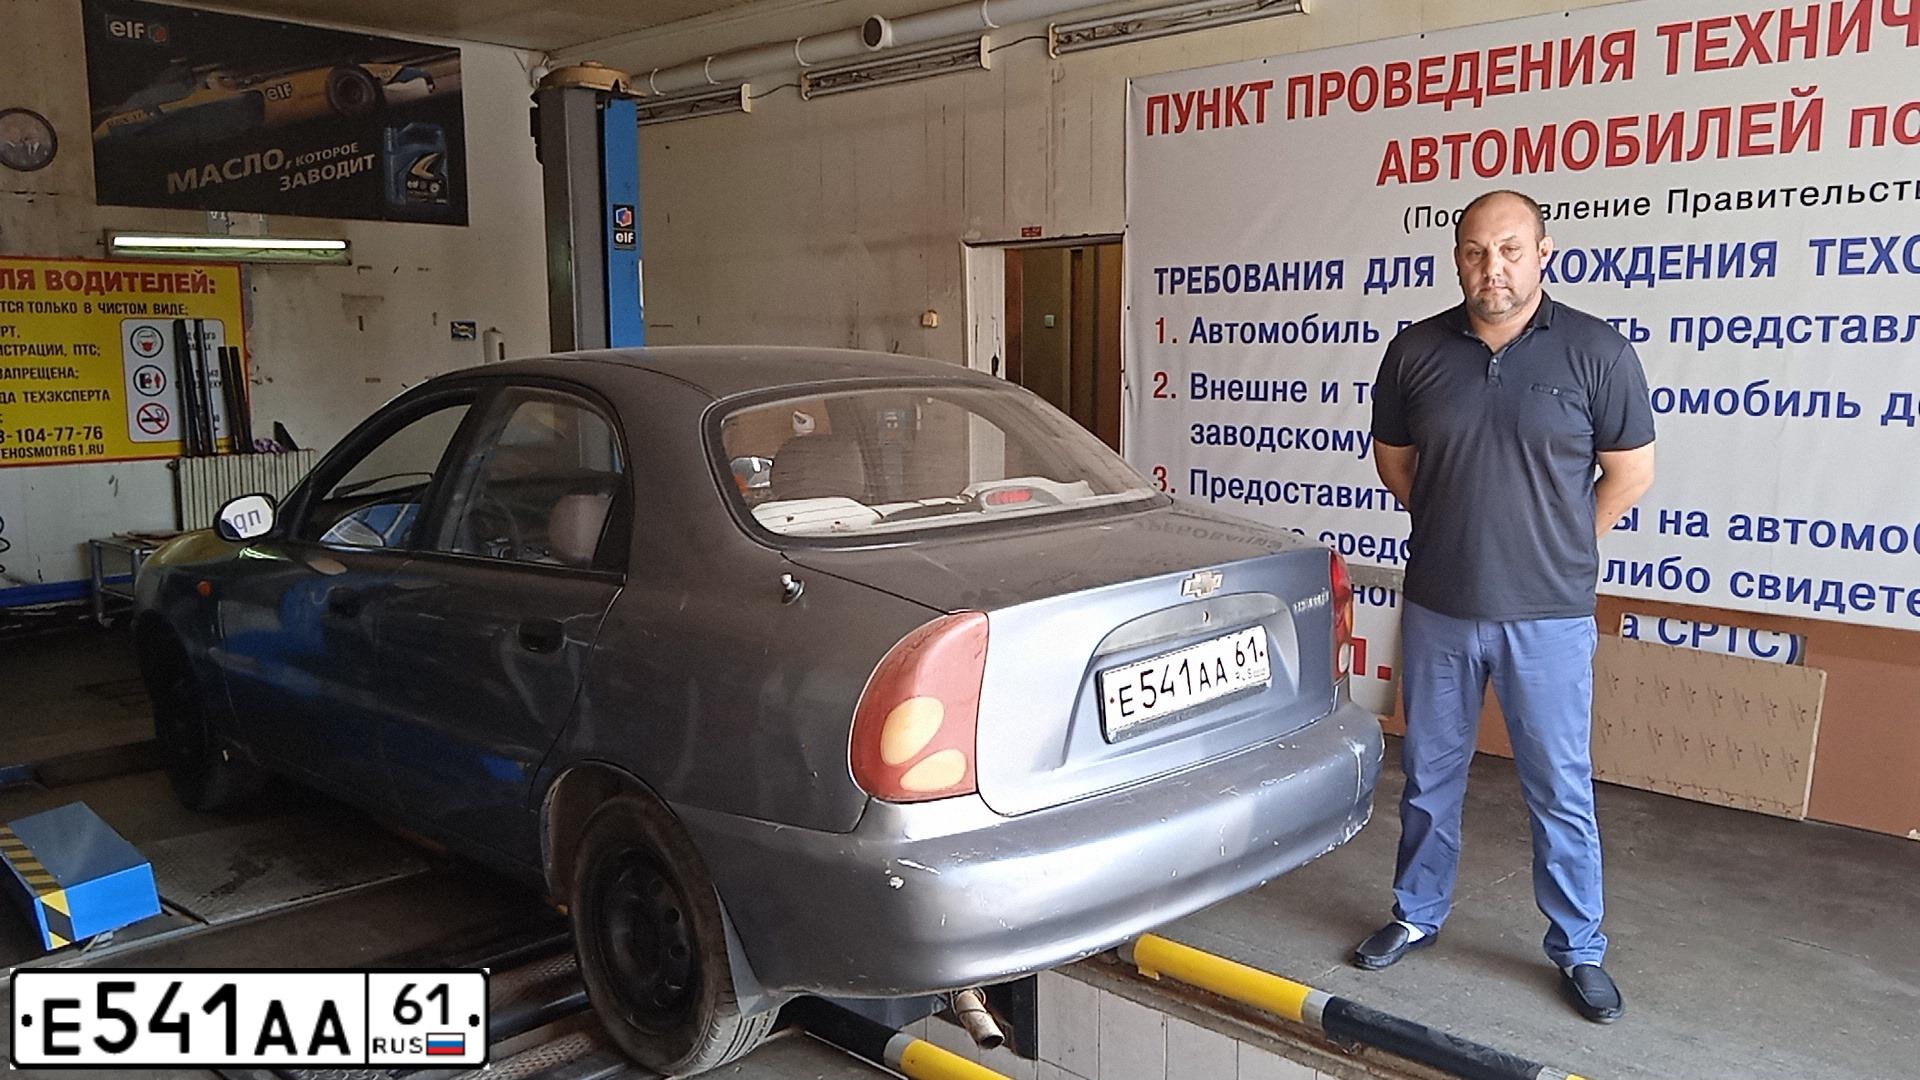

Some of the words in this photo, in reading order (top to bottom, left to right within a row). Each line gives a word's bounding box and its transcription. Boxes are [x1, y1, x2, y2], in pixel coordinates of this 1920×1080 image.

[110, 21, 145, 39] elf
[1147, 80, 1273, 136] ПУНКТ
[1287, 29, 1636, 120] ПРОВЕДЕНИЯ
[1656, 0, 1919, 75] ТЕХНИЧ
[267, 82, 292, 100] elf
[1377, 85, 1823, 186] АВТОМОБИЛЕЙ
[167, 149, 291, 194] МАСЛО,
[295, 142, 359, 167] КОТОРОЕ
[280, 154, 375, 192] ЗАВОДИТ
[616, 232, 634, 243] elf
[45, 269, 216, 296] ВОДИТЕЛЕЙ:
[1154, 260, 1344, 295] ТРЕБОВАНИЯ
[1364, 255, 1434, 295] ДЛЯ
[1541, 241, 1778, 289] ХОЖДЕНИЯ
[29, 302, 78, 314] ТОЛЬКО
[84, 303, 92, 314] В
[98, 303, 148, 315] ЧИСТОМ
[1155, 317, 1178, 344] 1.
[1189, 313, 1380, 344] Автомобиль
[1606, 318, 1651, 343] ть
[1670, 314, 1920, 351] представл
[23, 389, 111, 403] ТЕХЭКСПЕРТА
[1153, 372, 1176, 399] 2.
[1190, 373, 1307, 403] Внешне
[1321, 381, 1339, 403] и
[1353, 382, 1376, 405] т
[1651, 379, 1862, 419] омобиль
[1881, 392, 1920, 427] д
[1190, 423, 1373, 459] заводскому
[1153, 466, 1176, 494] 3.
[1659, 508, 1709, 538] на
[1728, 513, 1920, 556] автомо
[1602, 556, 1711, 594] либо
[1119, 657, 1228, 718] Е541АА
[1236, 636, 1257, 667] 61
